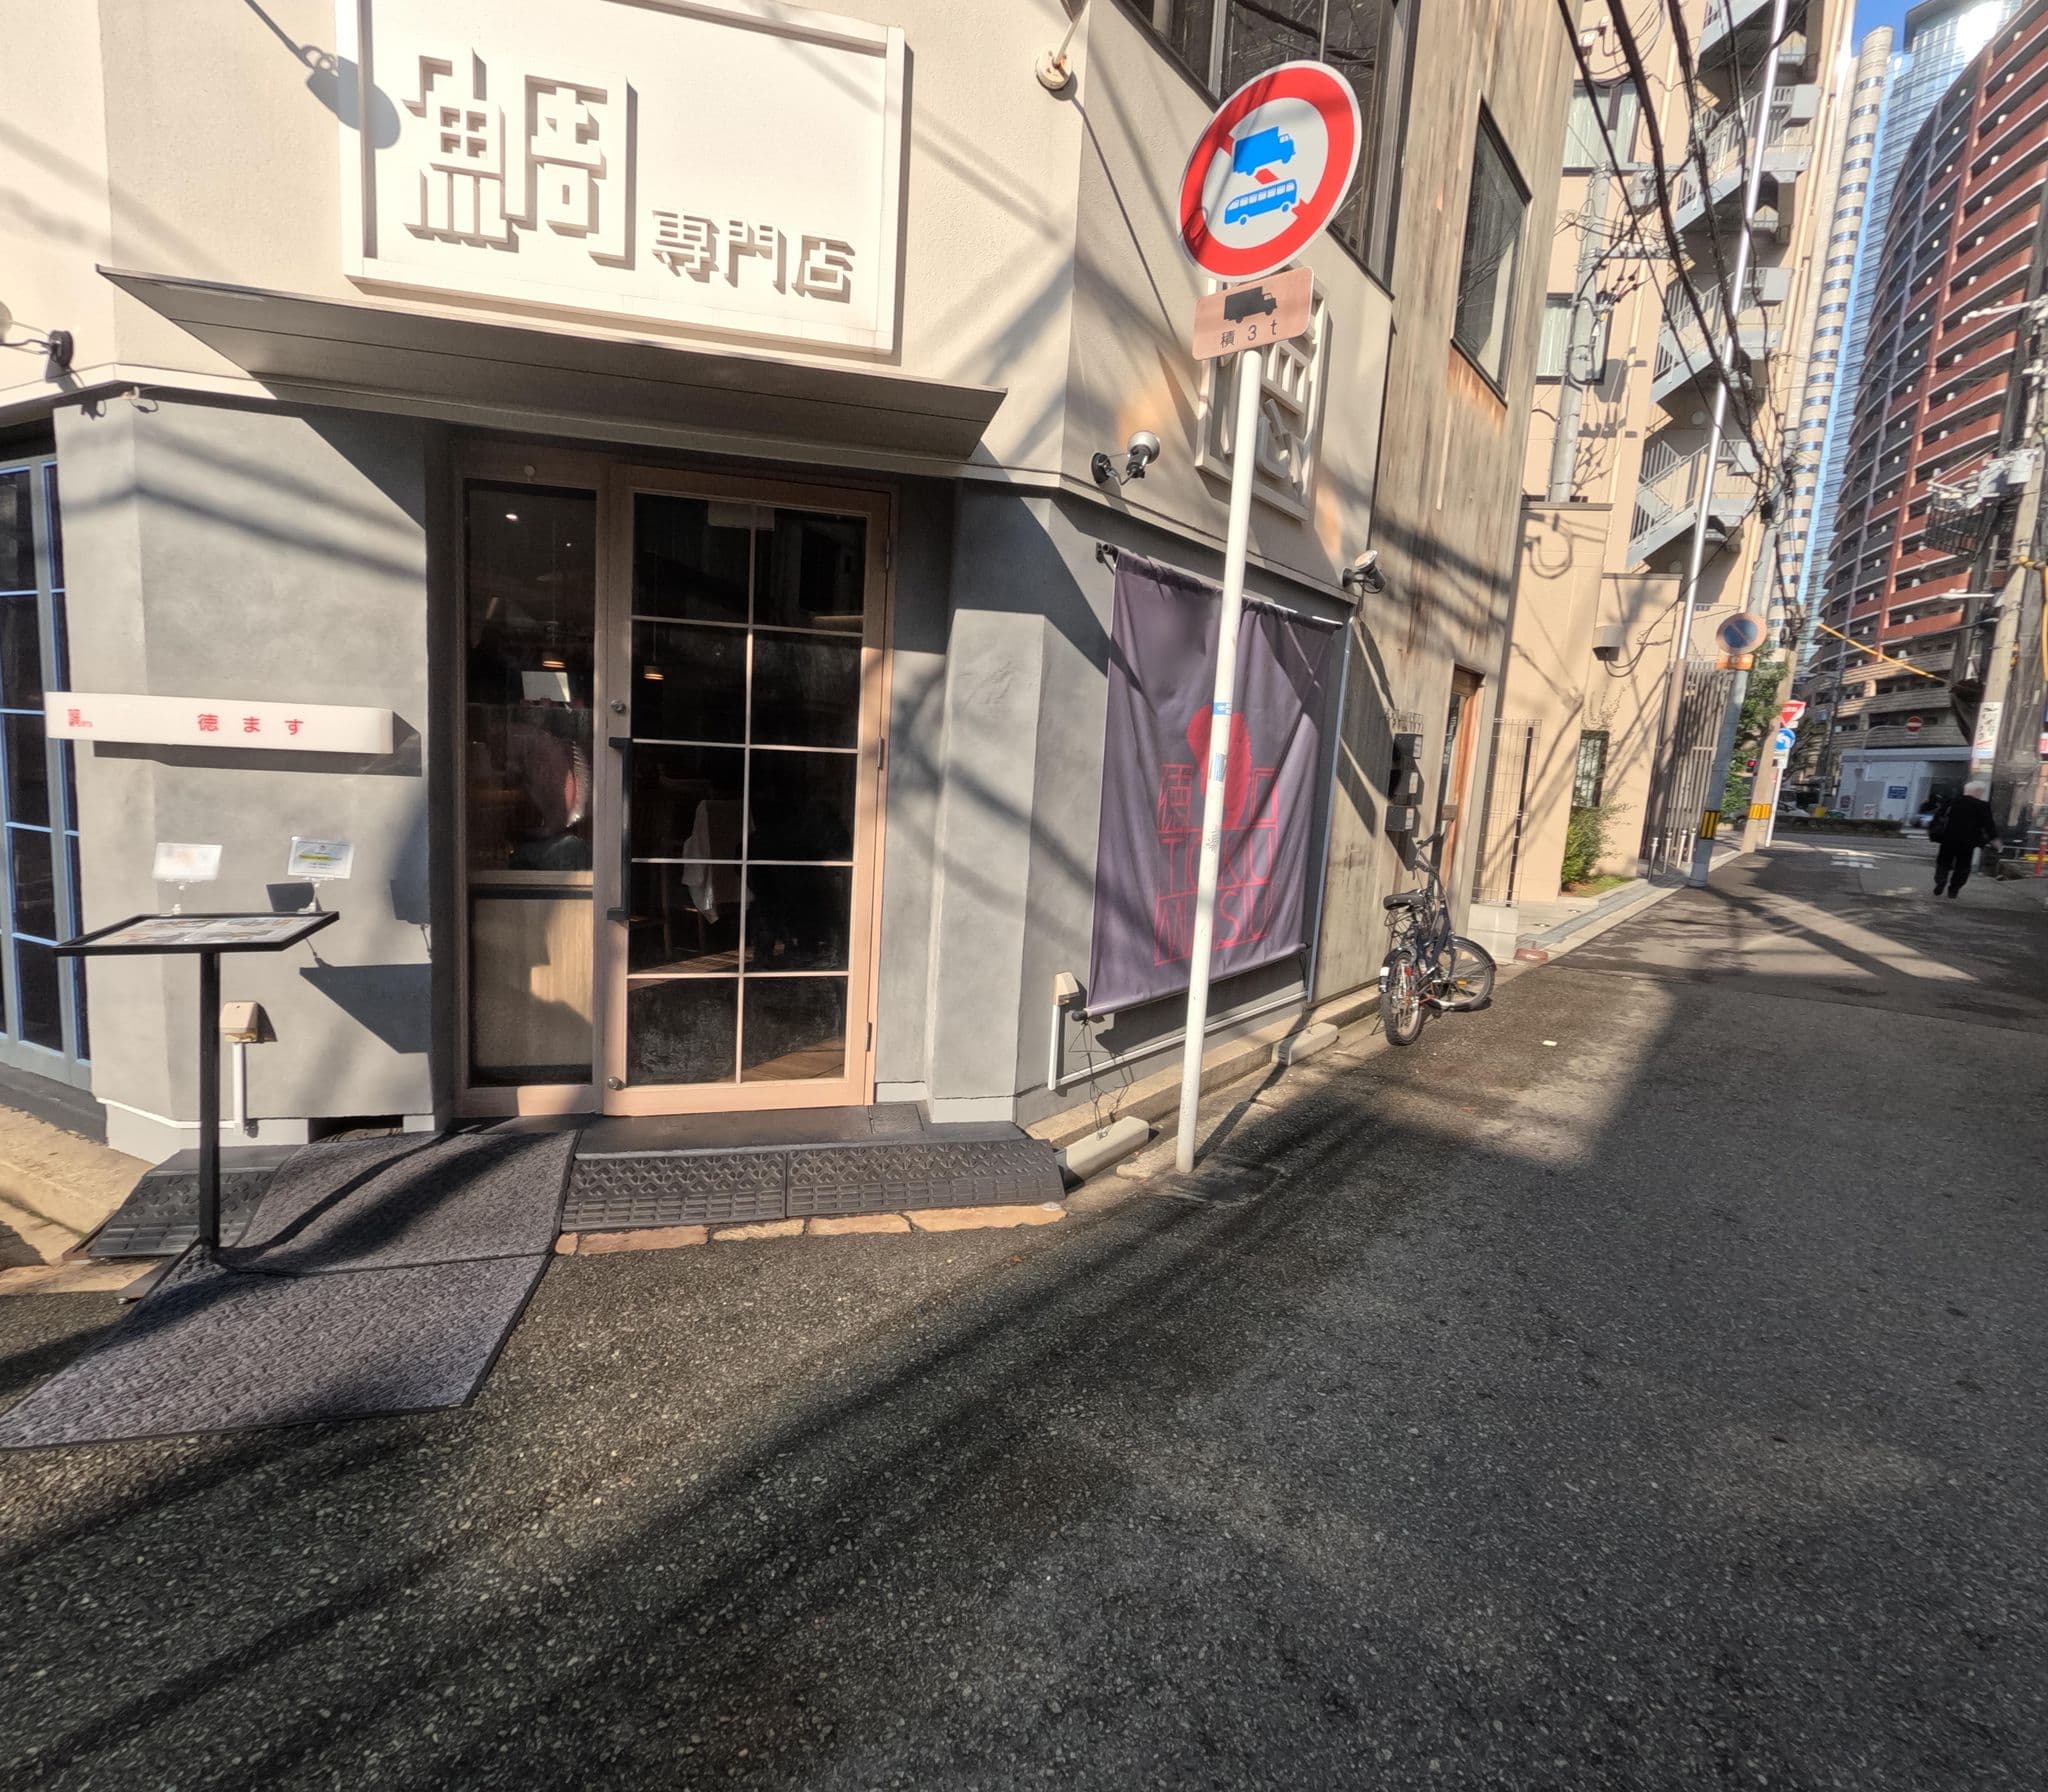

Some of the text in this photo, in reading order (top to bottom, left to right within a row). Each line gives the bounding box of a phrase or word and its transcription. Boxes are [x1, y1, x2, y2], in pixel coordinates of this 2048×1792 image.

[197, 713, 304, 736] 徳ます
[1154, 889, 1271, 966] MSU
